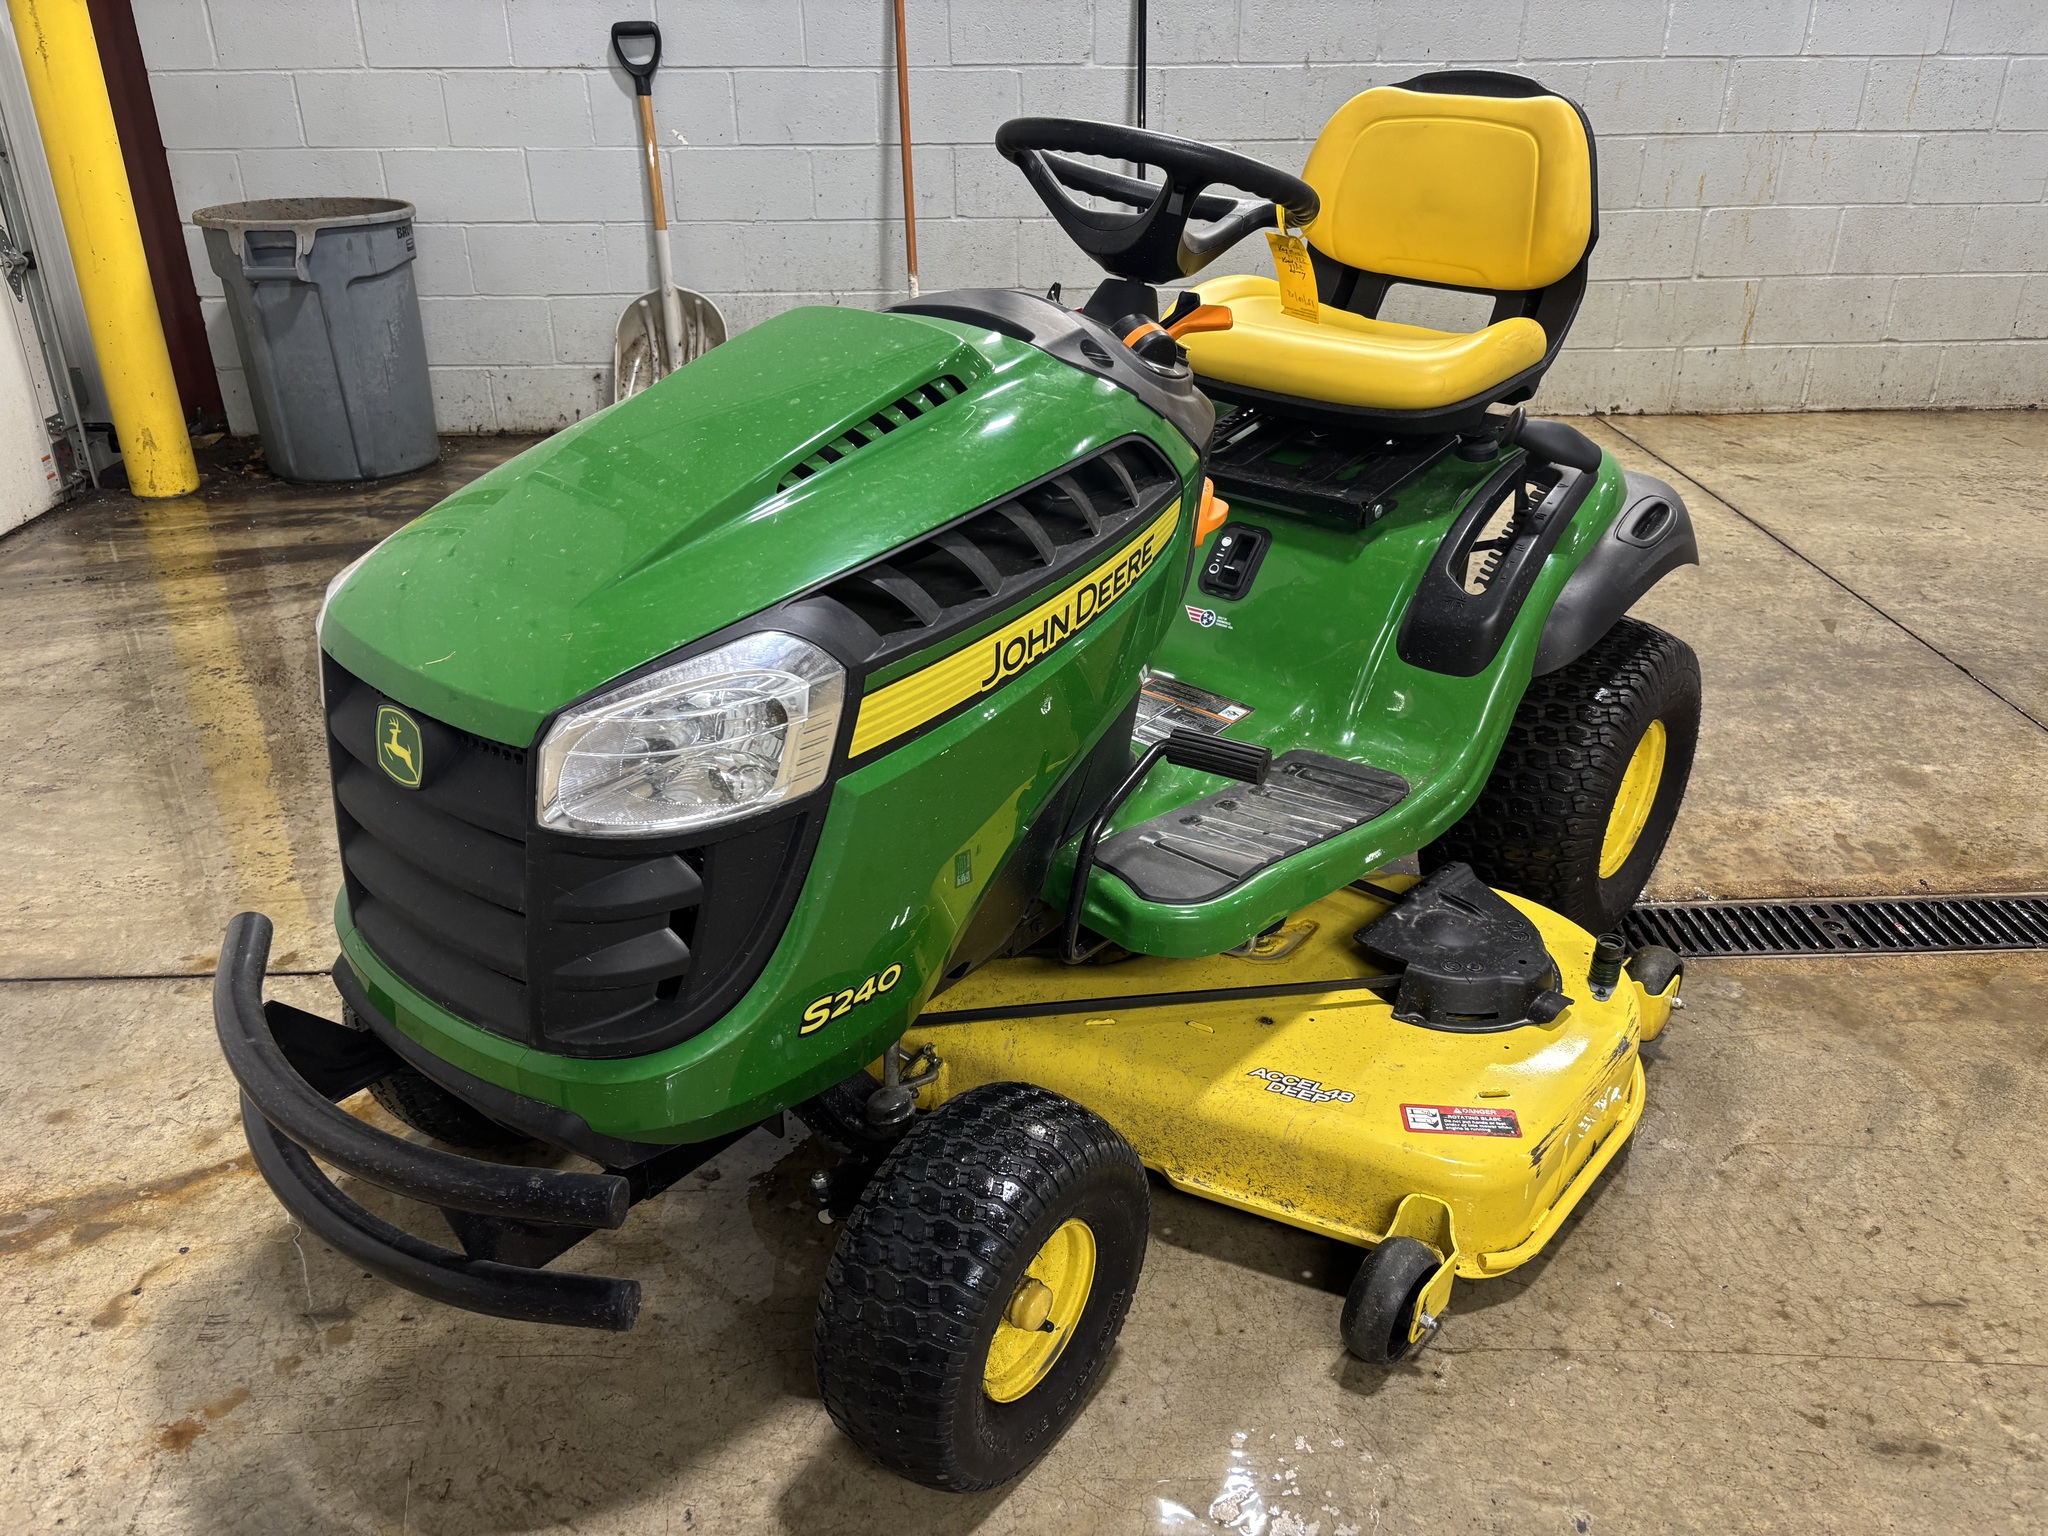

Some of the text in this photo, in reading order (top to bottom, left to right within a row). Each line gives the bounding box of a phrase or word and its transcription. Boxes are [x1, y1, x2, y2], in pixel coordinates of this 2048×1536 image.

[981, 534, 1155, 688] JOHN DEERE
[798, 962, 904, 1038] S240
[1247, 1068, 1356, 1103] ACCEL 48
[1265, 1081, 1331, 1103] DEEP
